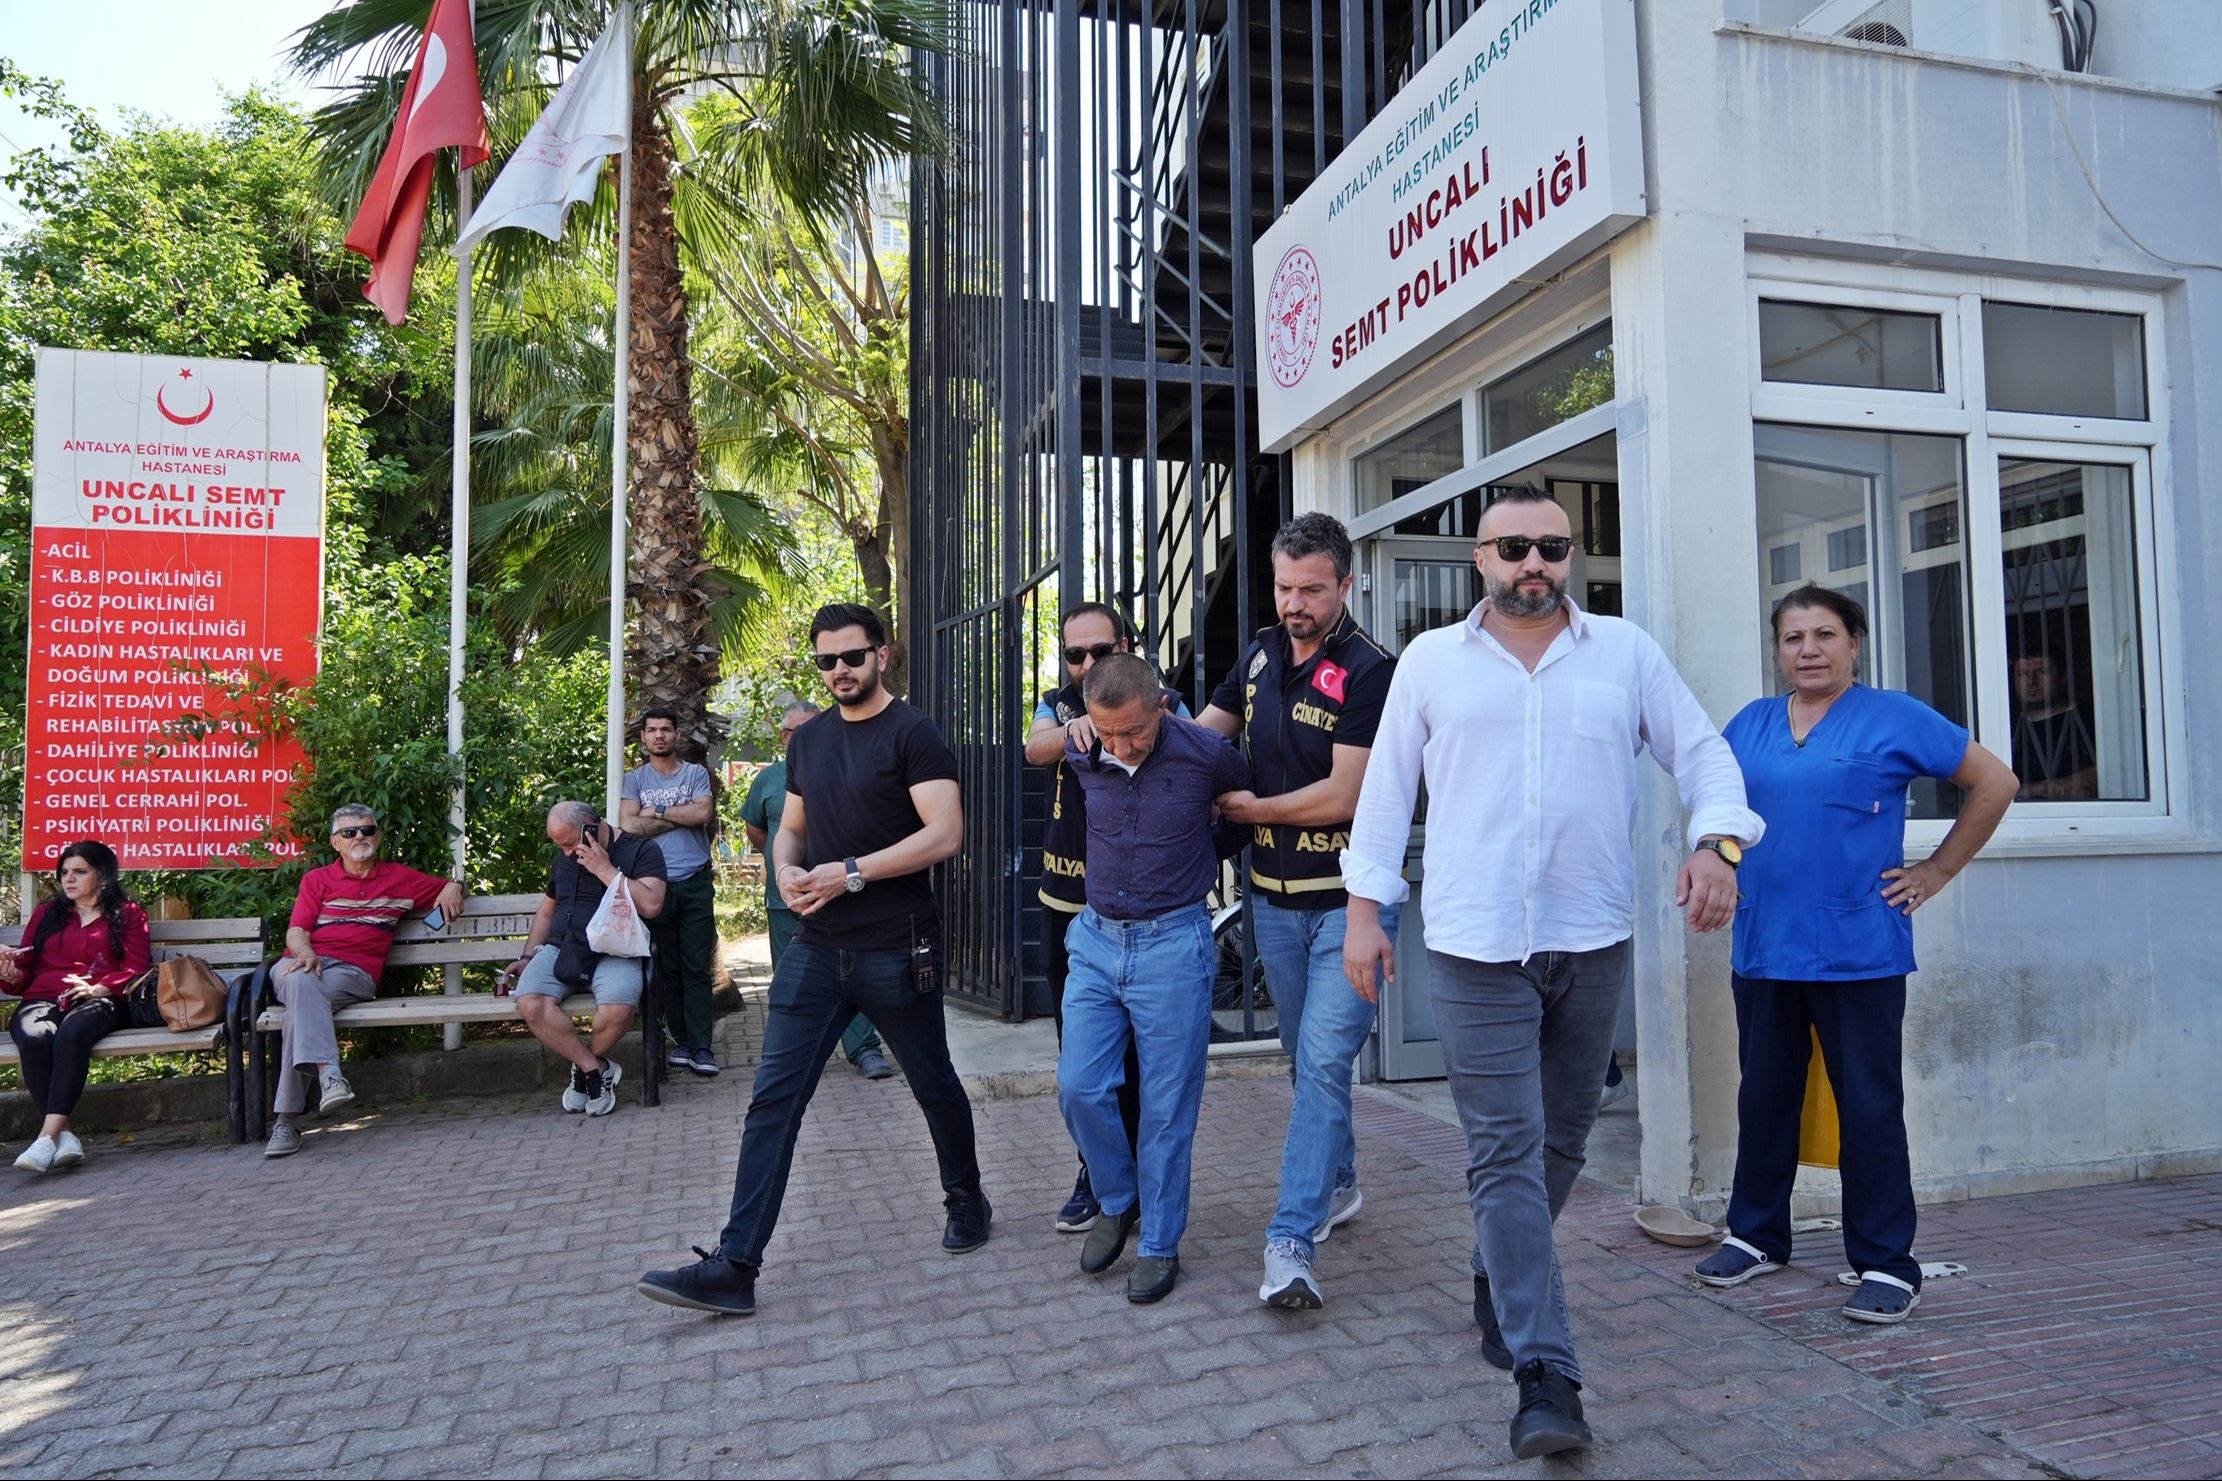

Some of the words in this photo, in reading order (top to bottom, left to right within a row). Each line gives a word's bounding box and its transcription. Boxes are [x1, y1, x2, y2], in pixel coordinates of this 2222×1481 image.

[1328, 155, 1383, 222] ANTALYA
[1386, 101, 1435, 166] EĞİTİM
[1438, 77, 1459, 112] VE
[1392, 101, 1479, 203] HASTANESİ
[1388, 145, 1490, 260] UNCALI
[1331, 297, 1390, 369] SEMT
[1397, 135, 1588, 323] POLİKLİNİĞİ
[63, 440, 131, 454] ANTALYA
[137, 443, 187, 457] EĞİTİM
[192, 447, 211, 458] VE
[215, 448, 301, 463] ARAŞTIRMA
[142, 461, 226, 476] HASTANESİ
[83, 480, 194, 502] UNCALI
[206, 485, 286, 506] SEMT
[92, 503, 274, 530] POLİKLİNİĞİ
[52, 569, 100, 583] K.B.B
[106, 568, 222, 588] POLİKLİNİĞİ
[51, 591, 93, 608] GÖZ
[99, 593, 215, 612] POLİKLİNİĞİ
[50, 616, 125, 634] CİLDİYE
[131, 618, 246, 637] POLİKLİNİĞİ
[50, 643, 113, 658] KADIN
[120, 645, 254, 661] HASTALIKLARI
[260, 648, 283, 662] VE
[47, 665, 128, 683] DOĞUM
[49, 690, 97, 708] FİZİK
[103, 692, 173, 709] TEDAVİ
[179, 695, 203, 709] VE
[47, 741, 138, 758] DAHİLİYE
[46, 769, 115, 786] ÇOCUK
[121, 769, 256, 784] HASTALIKLARI
[45, 794, 110, 808] GENEL
[115, 791, 200, 808] CERRAHİ
[206, 794, 248, 808] POL.
[45, 816, 150, 833] PSİKİYATRİ
[156, 814, 271, 833] POLİKLİNİĞİ
[123, 842, 256, 858] HASTALIKLAR
